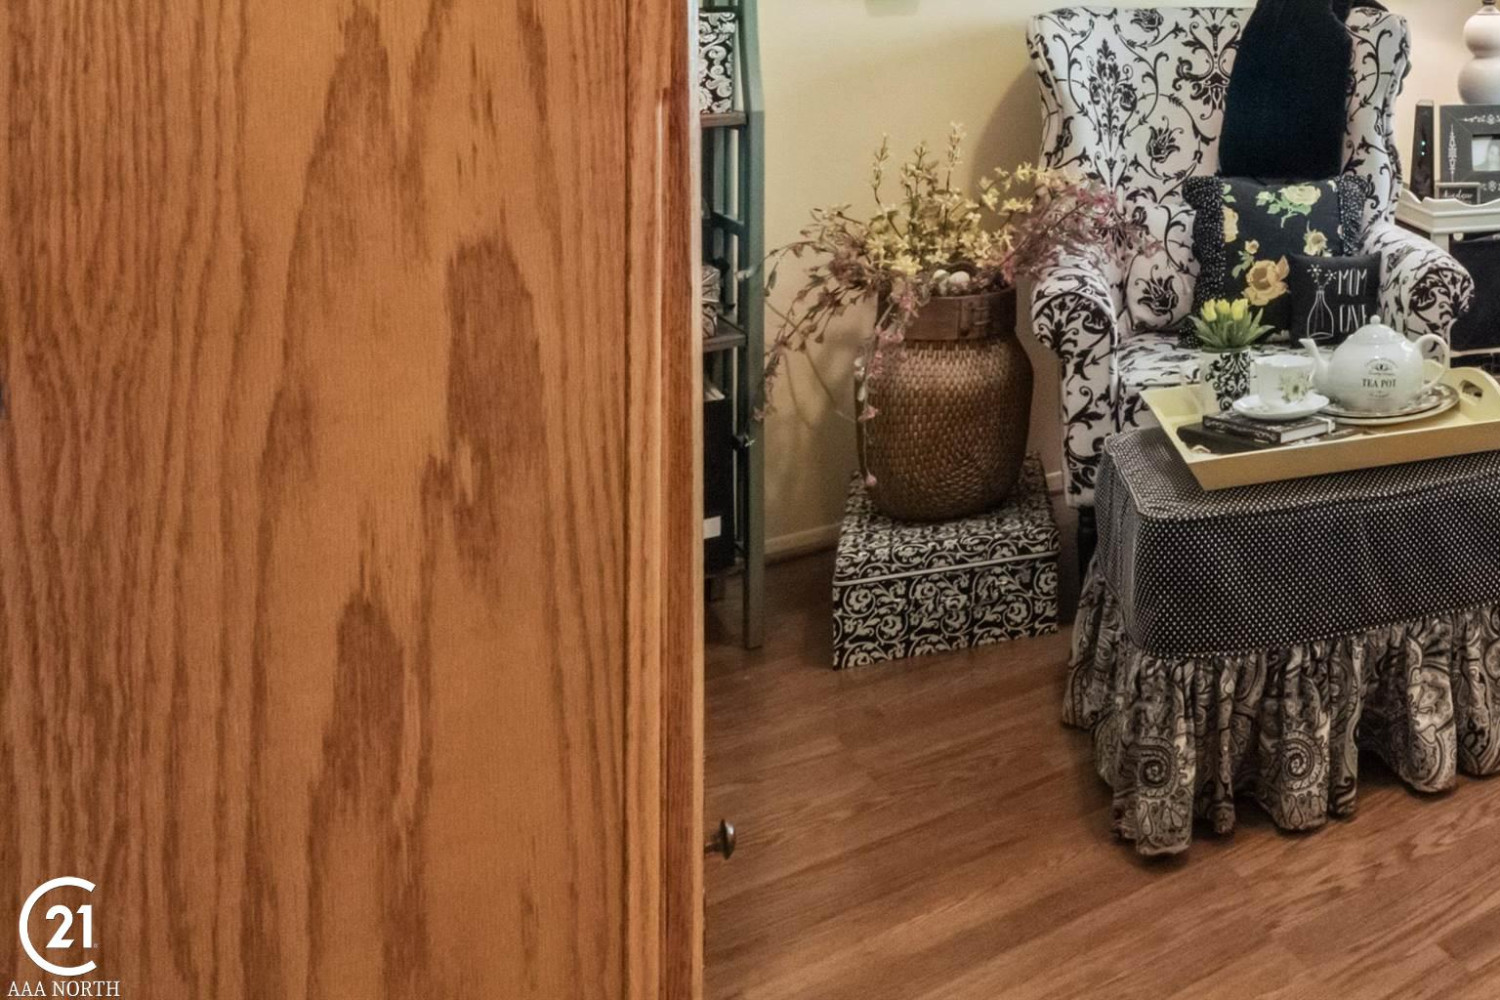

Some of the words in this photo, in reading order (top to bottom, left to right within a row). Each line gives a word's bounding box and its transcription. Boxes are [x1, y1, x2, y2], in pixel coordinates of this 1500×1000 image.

[1338, 269, 1367, 296] MOM
[1362, 378, 1378, 388] TEA
[1381, 379, 1396, 388] POT
